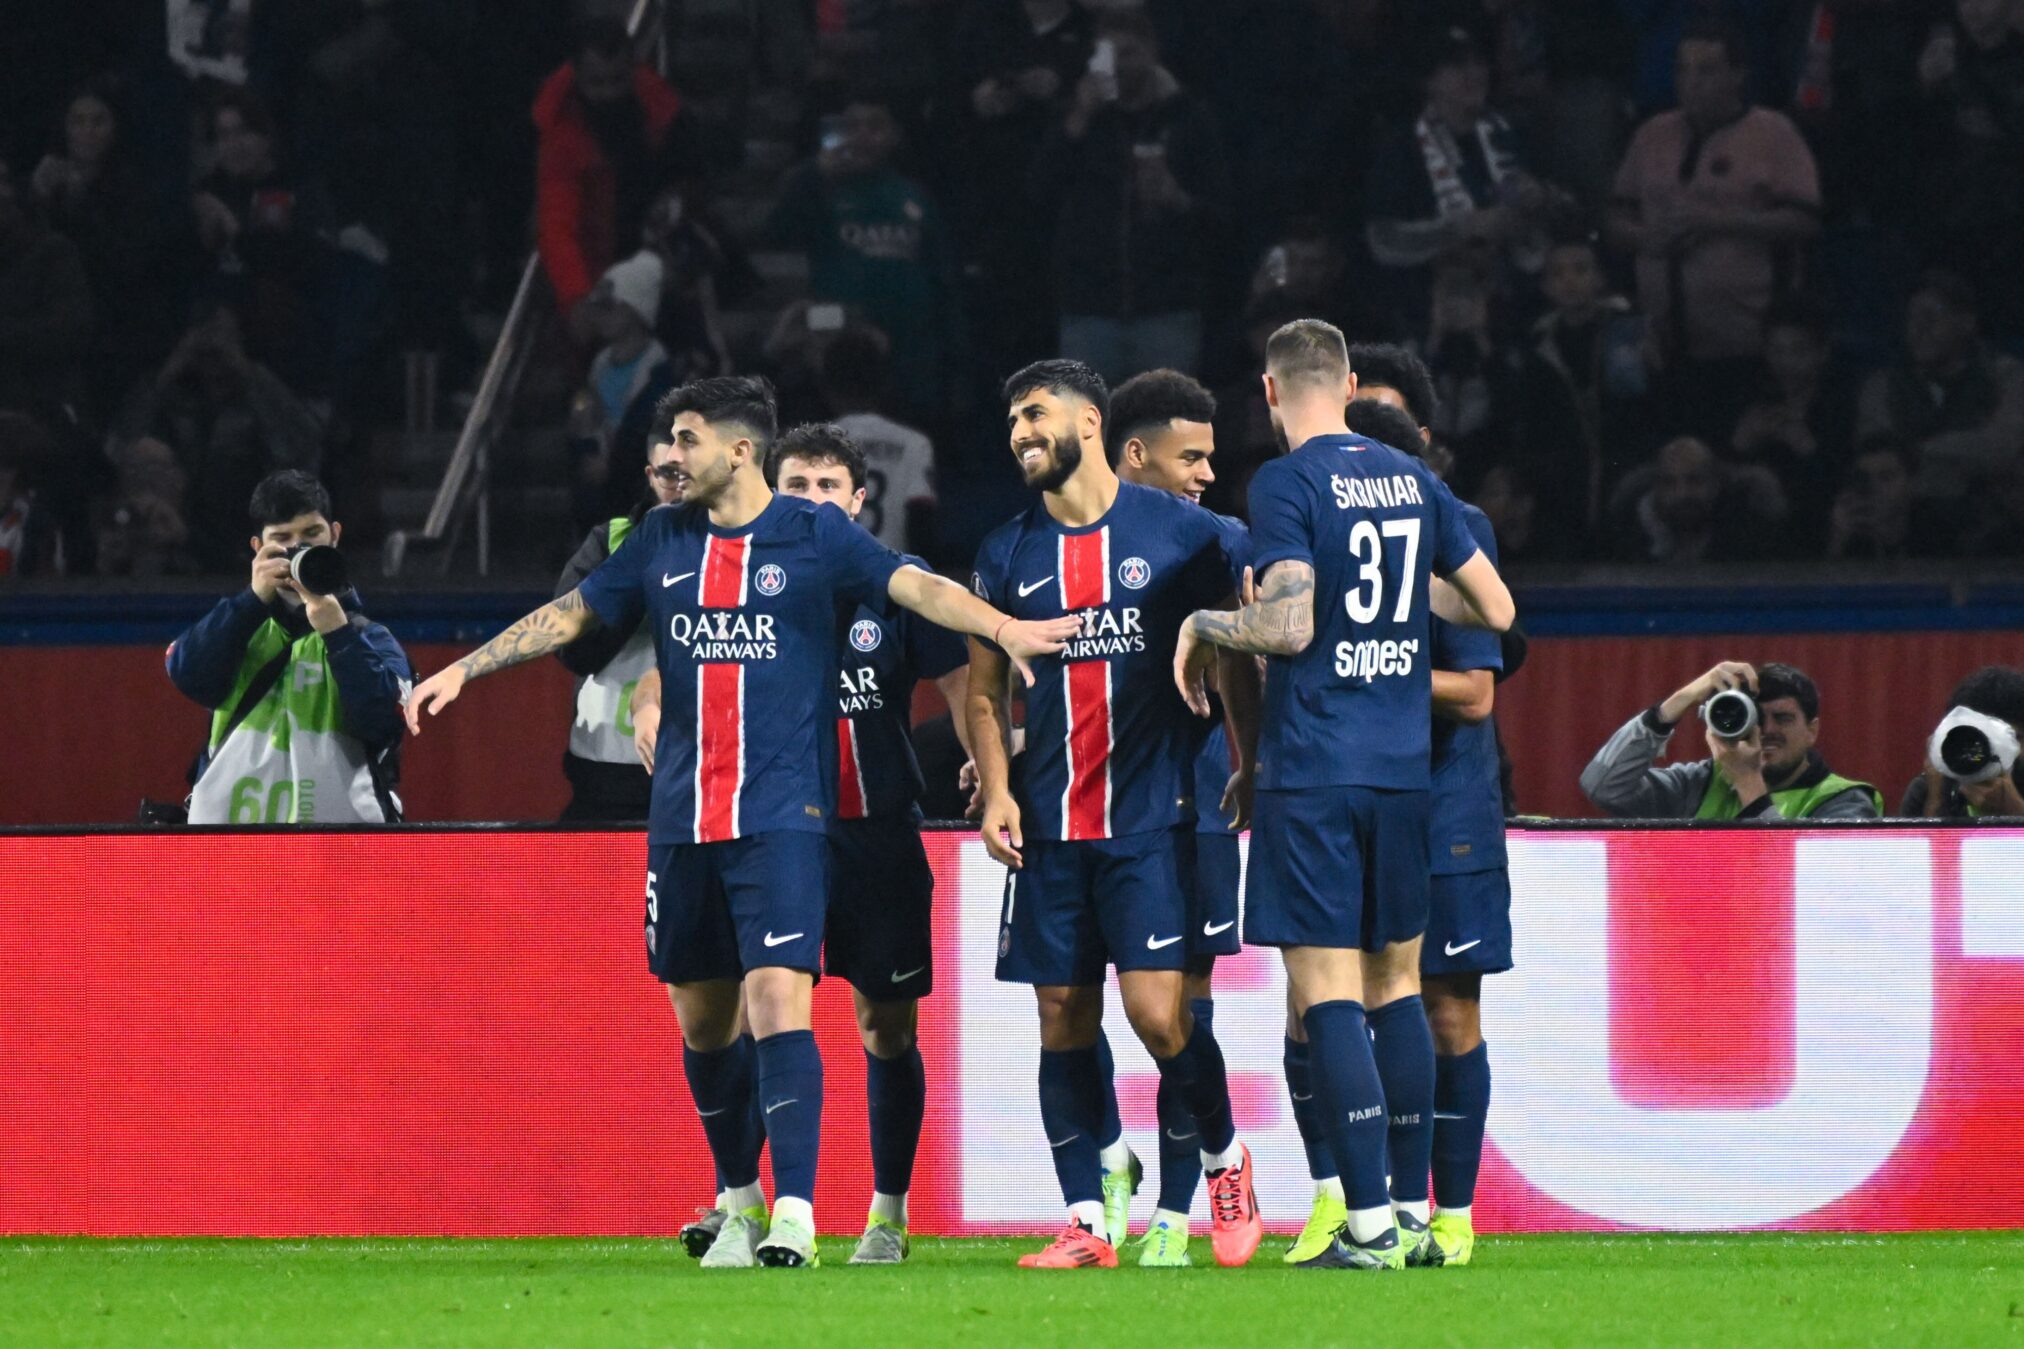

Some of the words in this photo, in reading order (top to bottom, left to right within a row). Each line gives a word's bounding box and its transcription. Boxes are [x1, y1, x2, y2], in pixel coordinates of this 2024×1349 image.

[1345, 518, 1421, 624] 37
[671, 612, 776, 646] QATAR
[1062, 607, 1144, 641] TAR
[692, 641, 777, 659] AIRWAYS
[1061, 635, 1146, 659] AIRWAYS
[1348, 1105, 1382, 1124] PARIS
